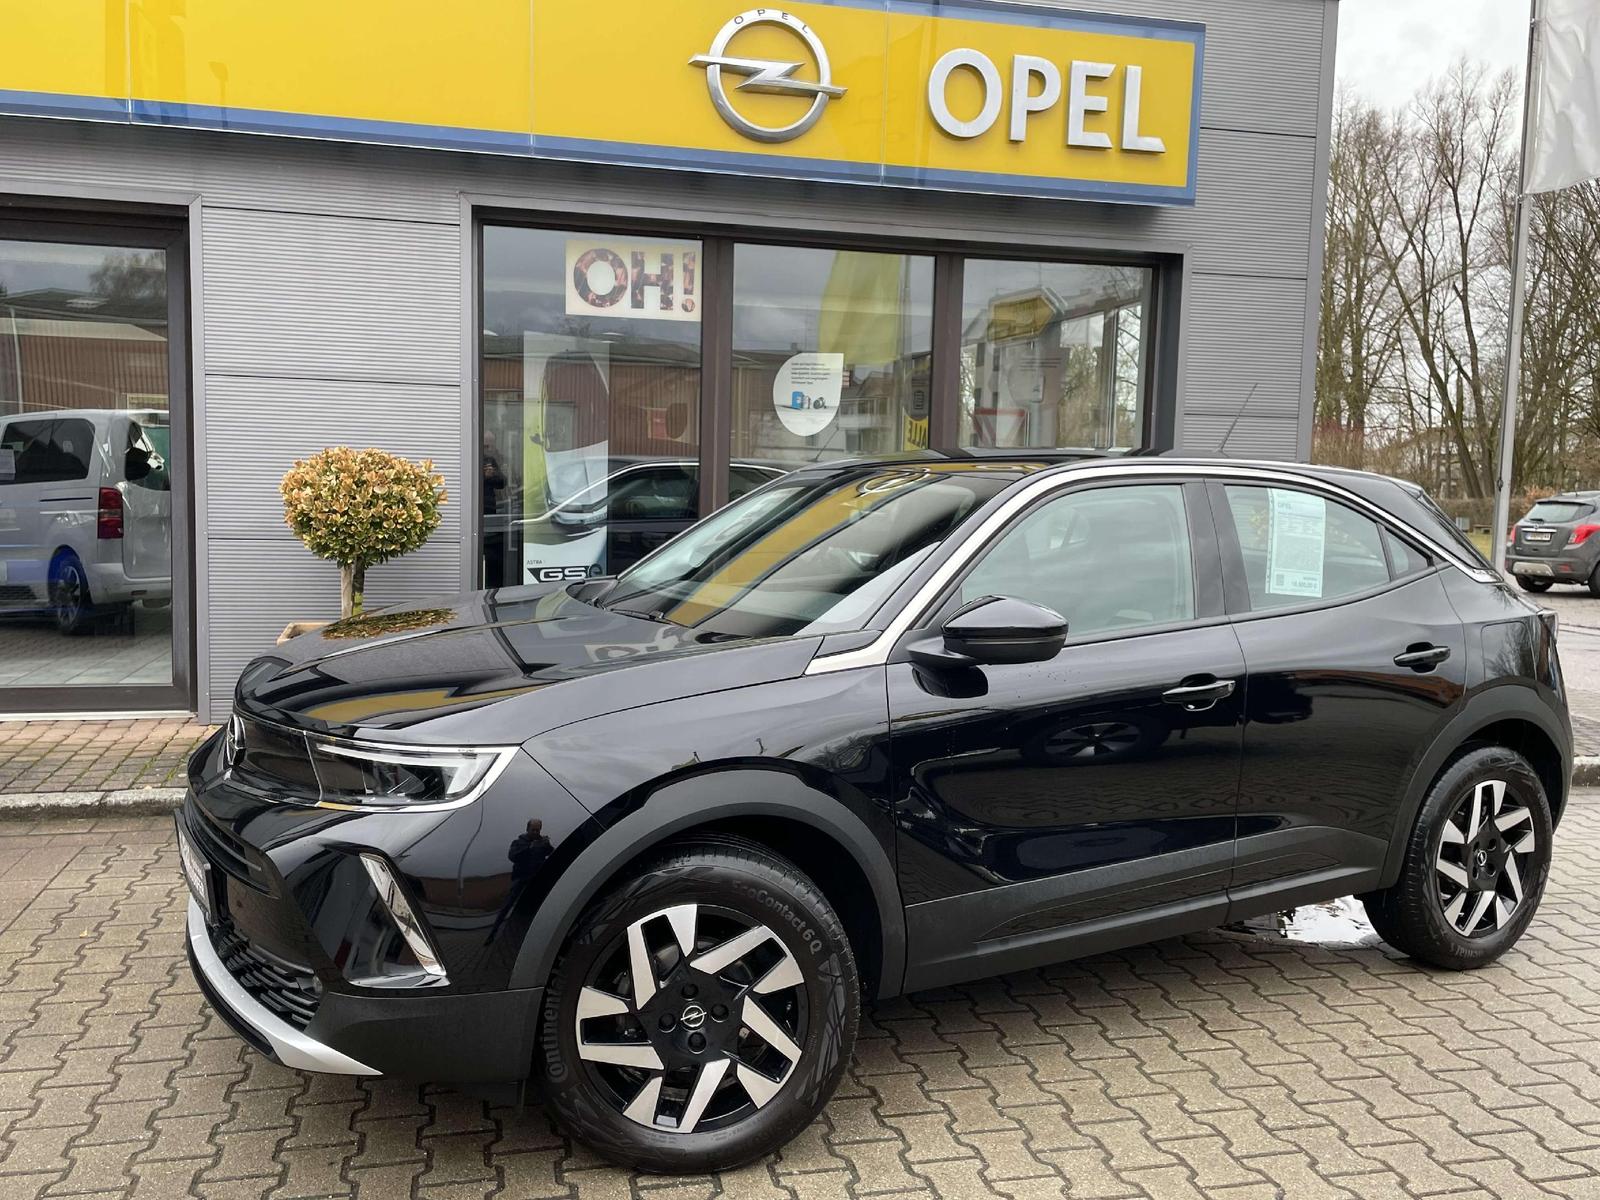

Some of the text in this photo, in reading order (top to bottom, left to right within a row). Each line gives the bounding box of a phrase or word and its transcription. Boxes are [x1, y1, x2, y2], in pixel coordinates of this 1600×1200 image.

[734, 9, 808, 33] OPEL
[929, 48, 1166, 153] OPEL
[574, 248, 696, 312] OH!
